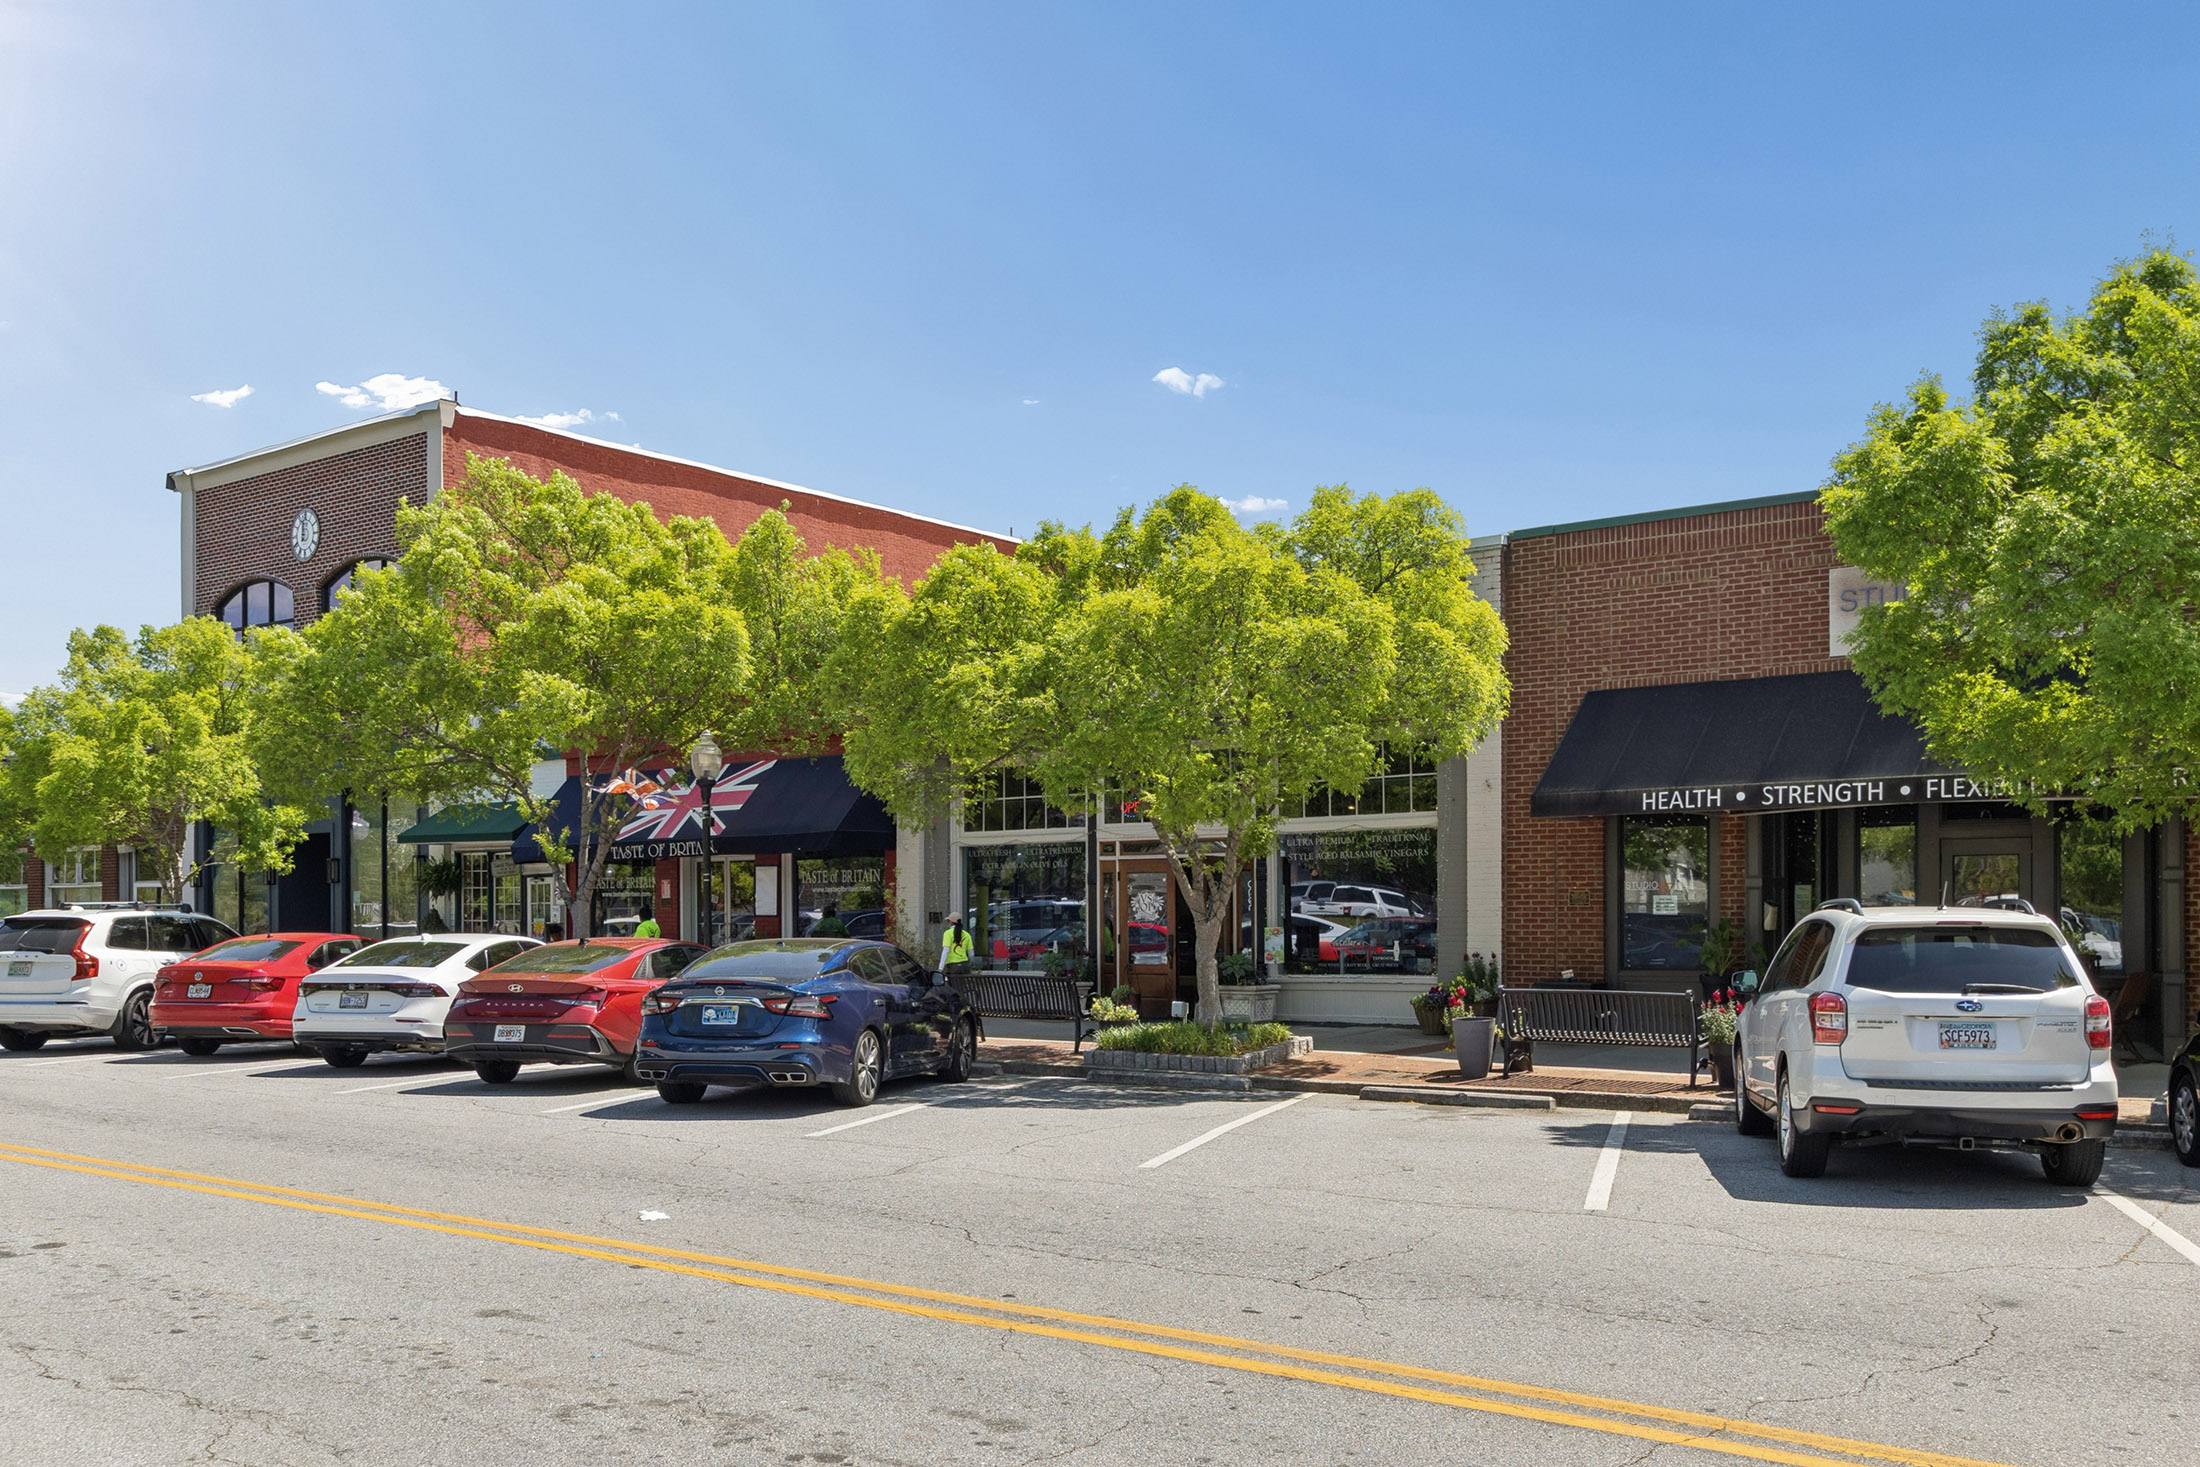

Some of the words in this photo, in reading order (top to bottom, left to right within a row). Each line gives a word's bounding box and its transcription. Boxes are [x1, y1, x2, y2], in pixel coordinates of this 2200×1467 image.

[1642, 788, 1722, 811] HEALTH
[1761, 782, 1884, 806] STRENGTH
[1120, 800, 1141, 814] OPE
[1286, 839, 1314, 847] ULTRA
[1315, 836, 1356, 846] PREMIUM
[1370, 832, 1432, 844] TRADITIONAL
[611, 844, 645, 860] TASTE
[648, 843, 665, 858] OF
[1287, 852, 1315, 861] STYLE
[1316, 851, 1339, 860] AGED
[1340, 849, 1382, 859] BALSAMIC
[1383, 848, 1430, 858] VINEGARS
[801, 870, 828, 884] TASTE
[830, 869, 838, 883] of
[841, 867, 882, 882] BRITAIN
[596, 877, 615, 889] ASTE
[1625, 880, 1659, 891] STUDIO
[1944, 1029, 1991, 1043] SCF5973
